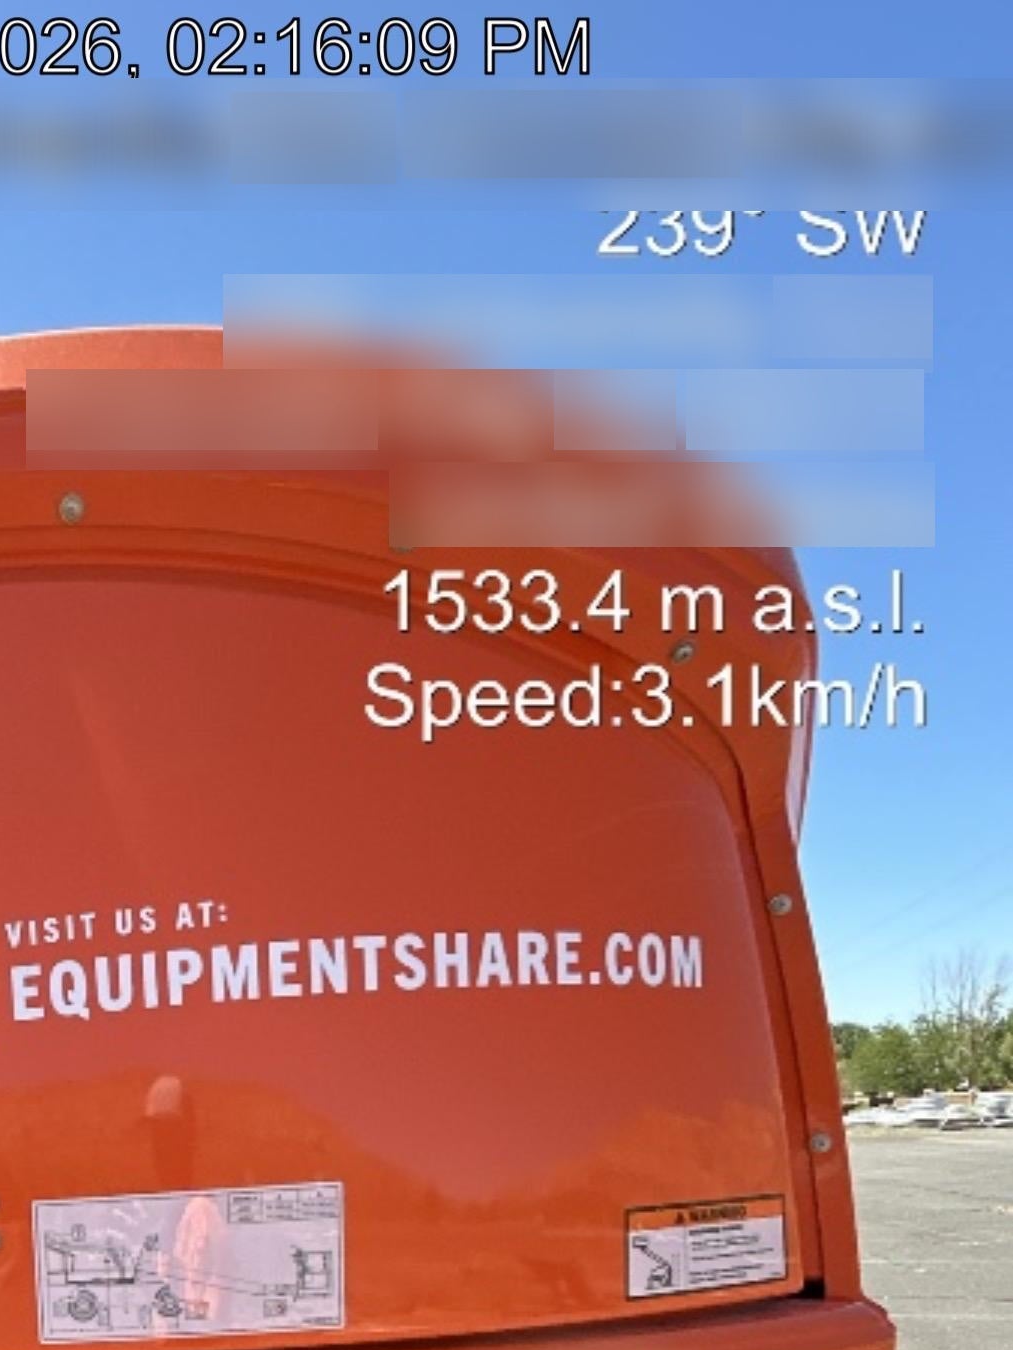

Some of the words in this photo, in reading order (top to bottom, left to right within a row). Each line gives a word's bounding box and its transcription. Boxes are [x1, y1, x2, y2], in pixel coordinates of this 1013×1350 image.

[5, 913, 96, 949] VISIT
[114, 908, 157, 936] US
[175, 900, 229, 929] AT:
[9, 931, 704, 1022] EQUIPMENTSHARE.COM
